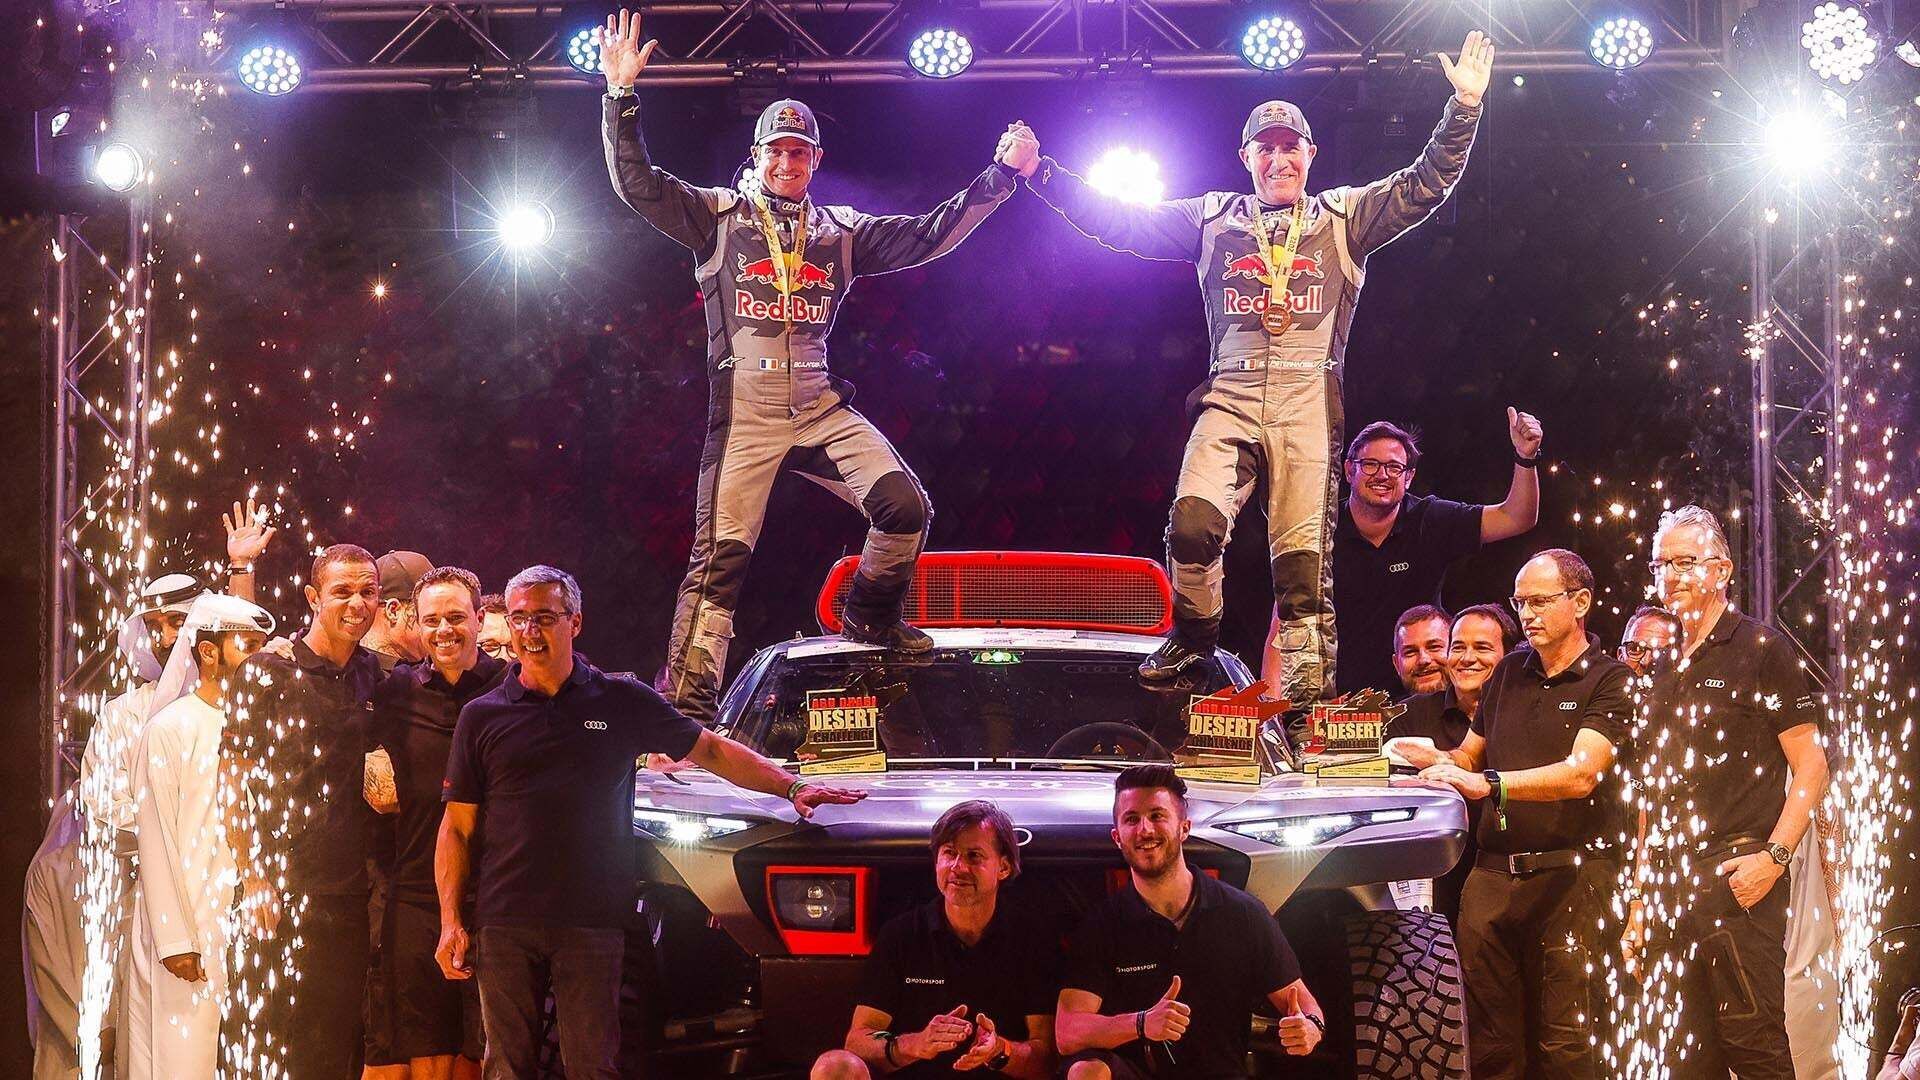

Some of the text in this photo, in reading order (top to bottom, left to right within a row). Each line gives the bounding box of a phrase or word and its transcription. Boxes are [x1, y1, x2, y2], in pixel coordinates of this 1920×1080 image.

[1287, 236, 1297, 252] 2022
[735, 289, 831, 324] Red Bull
[1223, 287, 1270, 315] Red
[812, 696, 876, 709] ABU DHABI
[1221, 704, 1259, 718] DHABI
[809, 708, 878, 730] DESERT
[1351, 712, 1382, 722] DHABI
[1189, 714, 1259, 738] DESERT
[1327, 721, 1383, 739] DESERT
[811, 729, 874, 742] CHALLENGE
